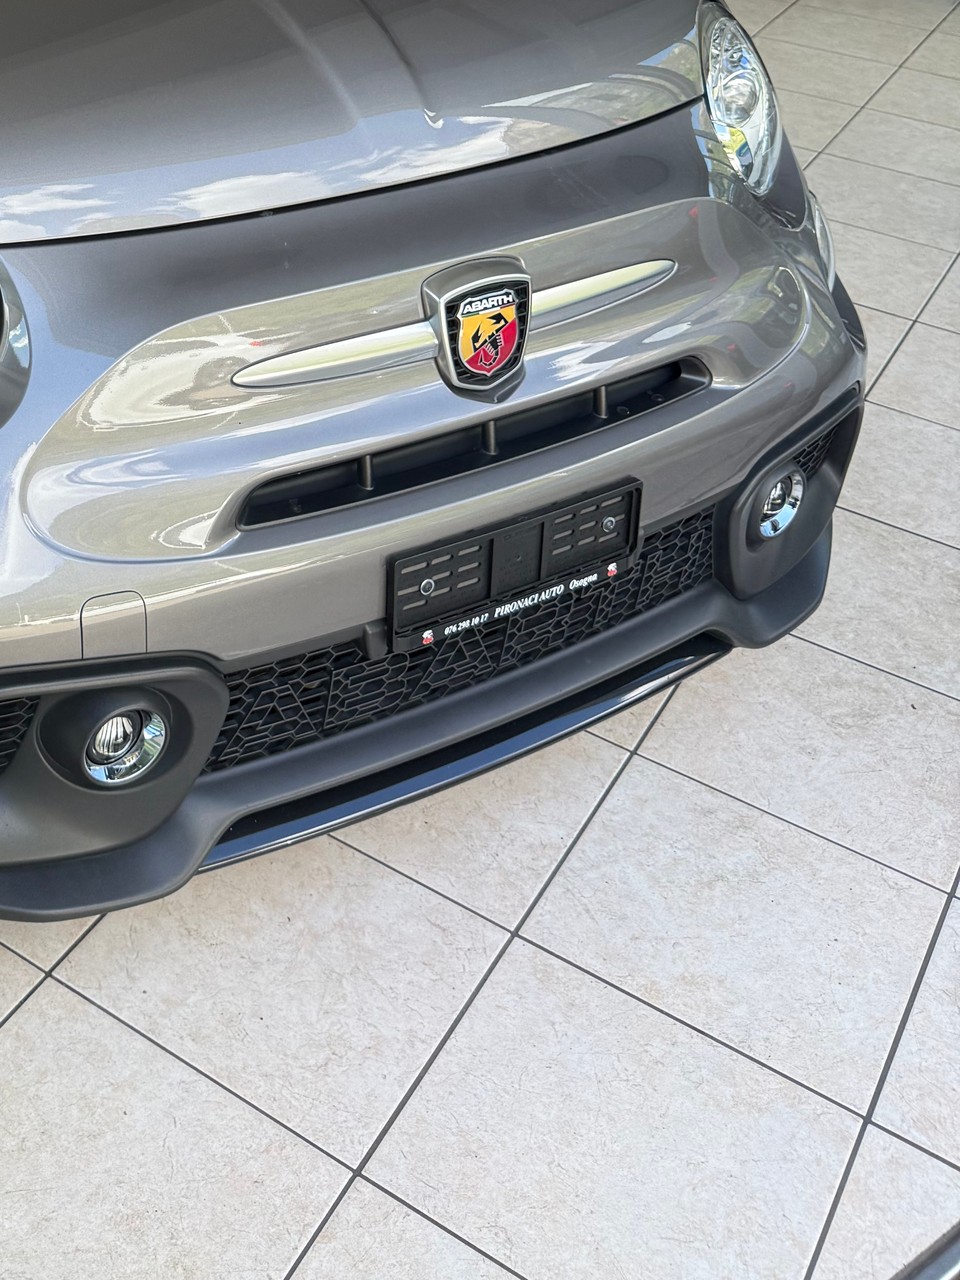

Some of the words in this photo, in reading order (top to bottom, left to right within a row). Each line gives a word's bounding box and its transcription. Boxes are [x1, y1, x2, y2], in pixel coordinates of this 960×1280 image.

[462, 294, 513, 314] ABARTH
[444, 624, 457, 636] 076
[458, 619, 471, 631] 298
[471, 616, 480, 626] 10
[480, 613, 489, 623] 17
[494, 593, 539, 618] PIRONACI
[538, 584, 565, 602] AUTO
[569, 573, 598, 590] Osogna
